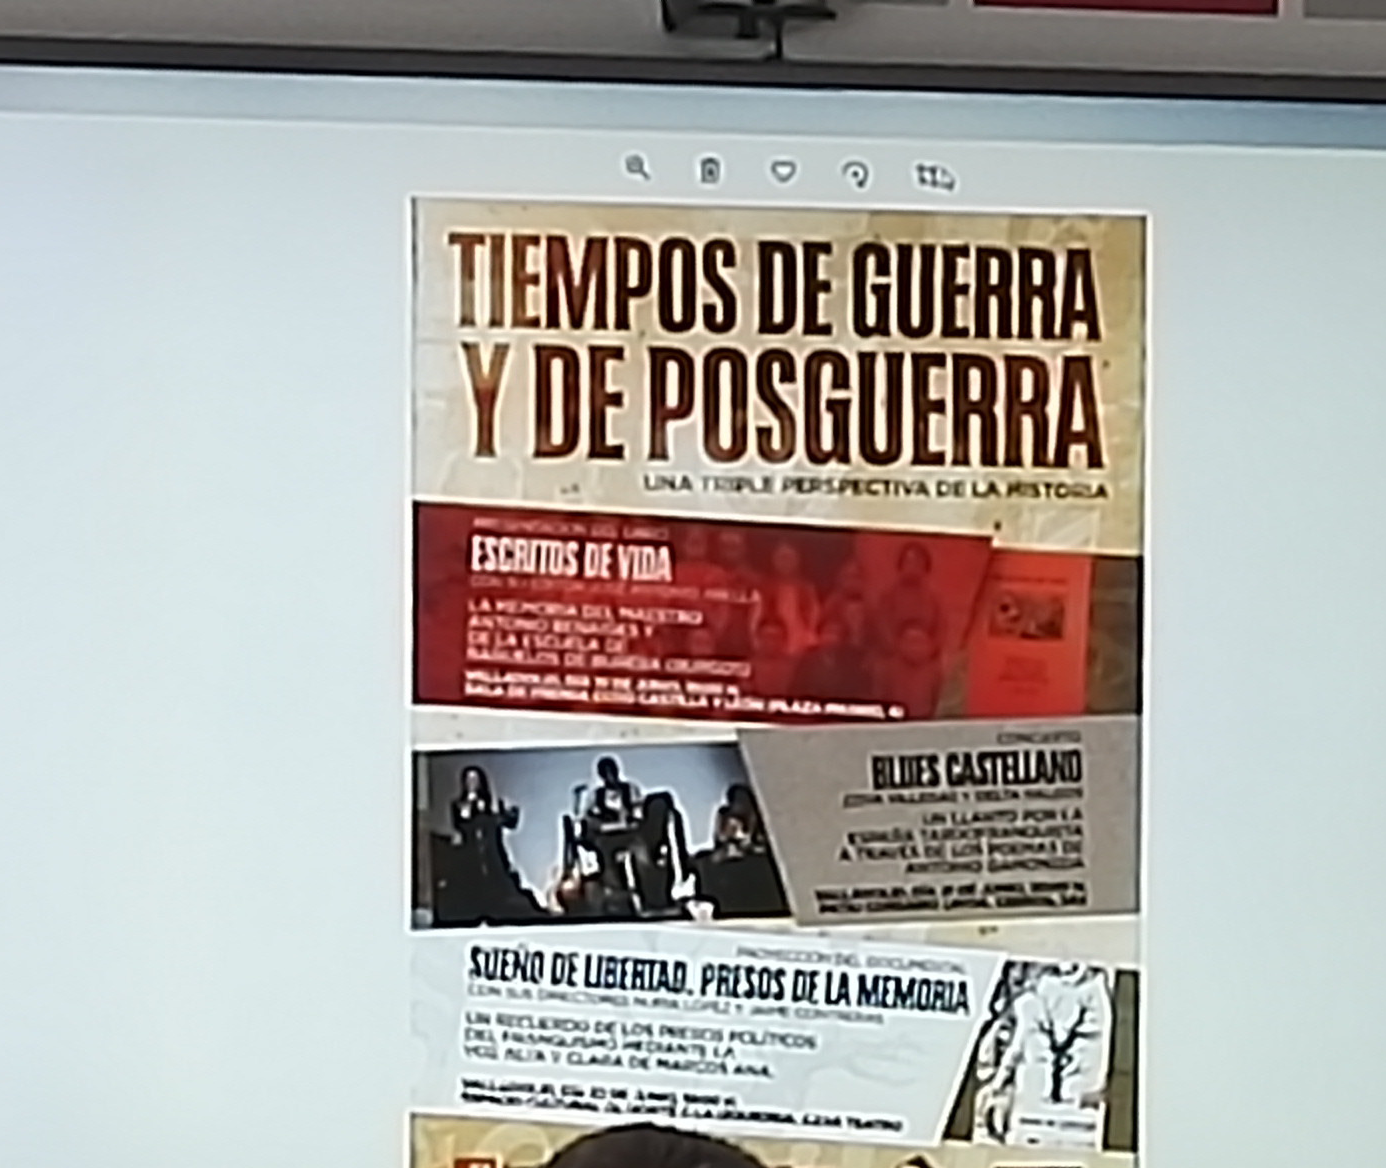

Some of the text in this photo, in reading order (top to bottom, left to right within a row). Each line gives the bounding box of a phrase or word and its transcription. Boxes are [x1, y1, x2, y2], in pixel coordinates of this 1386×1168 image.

[447, 231, 1104, 341] TIEMPOS DE GUERRA
[459, 341, 1105, 468] Y DE POSGUERRA
[643, 474, 1109, 500] UNA TRIPLE PERSPECTIVA DE LA HISTORIA
[471, 533, 673, 583] ESCRITOS DE VIDA
[467, 598, 492, 613] LA
[871, 748, 1084, 791] BLUES CASTELLANO
[468, 943, 546, 985] SUEÑO
[550, 951, 580, 987] DE
[700, 962, 786, 1002] PRESOS
[791, 968, 821, 1005] DE
[824, 969, 851, 1007] LA
[857, 973, 971, 1016] MEMORIA
[464, 1026, 496, 1042] DEL
[465, 1010, 492, 1026] UN
[594, 1019, 616, 1034] DE
[619, 1021, 654, 1037] LOS
[659, 1023, 724, 1043] PRESOS
[628, 1054, 650, 1070] DE
